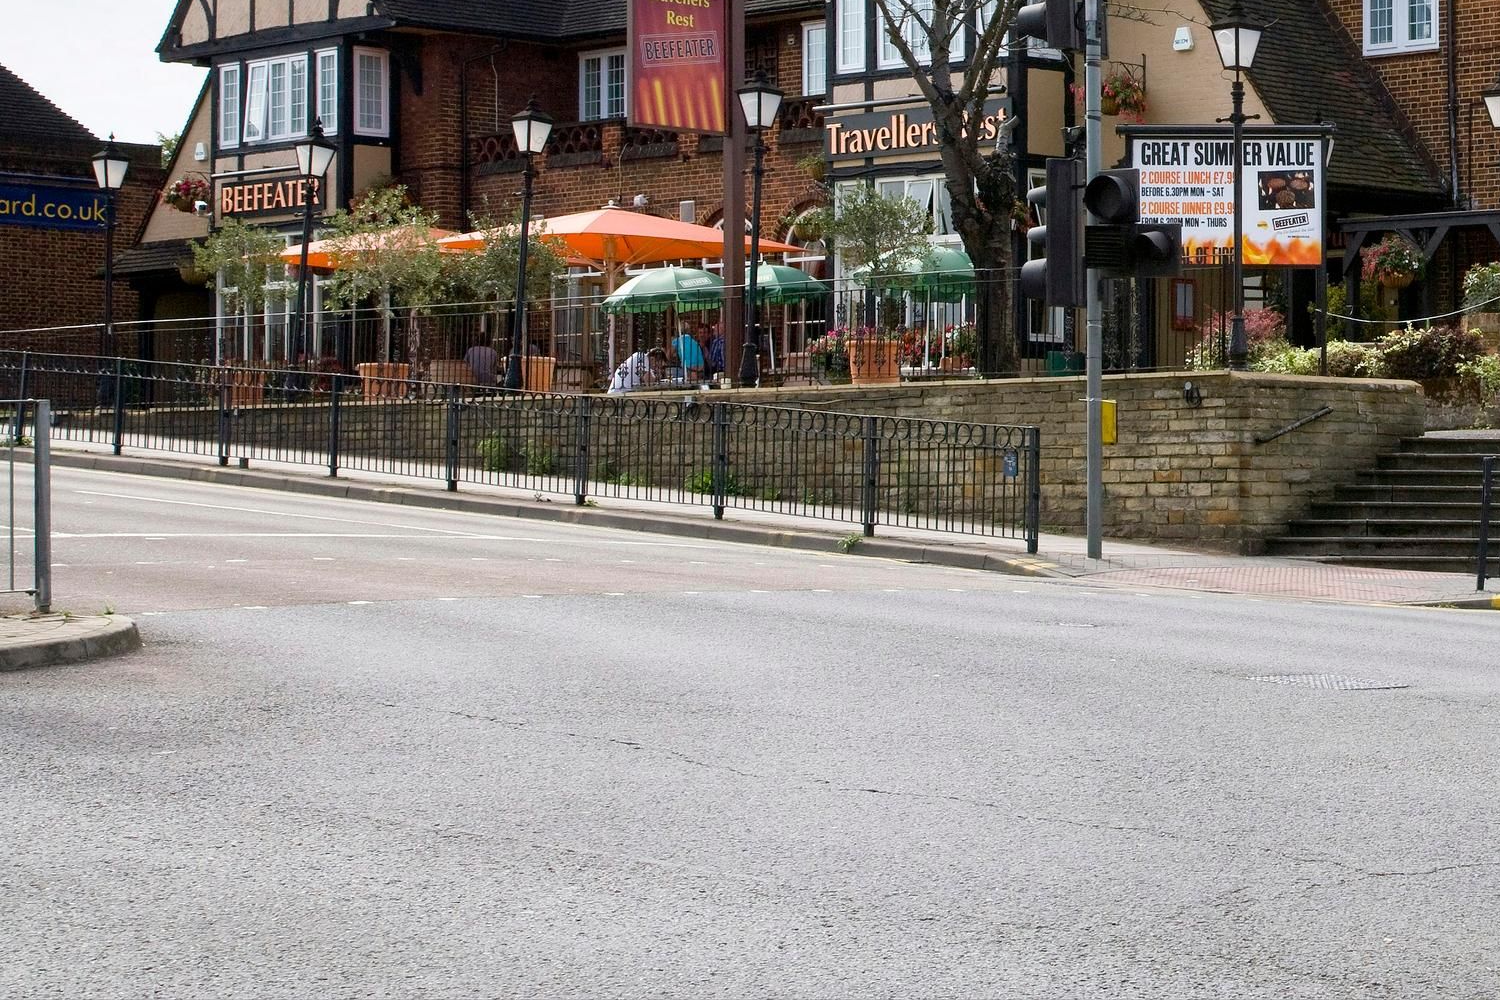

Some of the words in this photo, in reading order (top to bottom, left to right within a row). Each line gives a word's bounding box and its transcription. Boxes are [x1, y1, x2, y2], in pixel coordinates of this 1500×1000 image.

[666, 10, 694, 27] Rest
[645, 38, 715, 60] BEEFEATER
[1141, 142, 1190, 166] GREAT
[1266, 142, 1315, 166] VALUE
[1141, 171, 1147, 185] 2
[1148, 171, 1181, 185] COURSE
[1183, 171, 1211, 185] LUNCH
[1213, 171, 1234, 185] £7.9
[1141, 186, 1164, 197] BEFORE
[1165, 186, 1189, 197] 6.30PM
[1190, 186, 1205, 197] MON
[1212, 186, 1225, 197] SAT
[1141, 201, 1147, 215] 2
[1148, 201, 1181, 215] COURSE
[1182, 201, 1213, 215] DINNER
[1214, 201, 1235, 215] £9.9
[1185, 217, 1200, 228] MON
[1207, 217, 1228, 228] THURS
[1275, 214, 1307, 228] BEEFEATER
